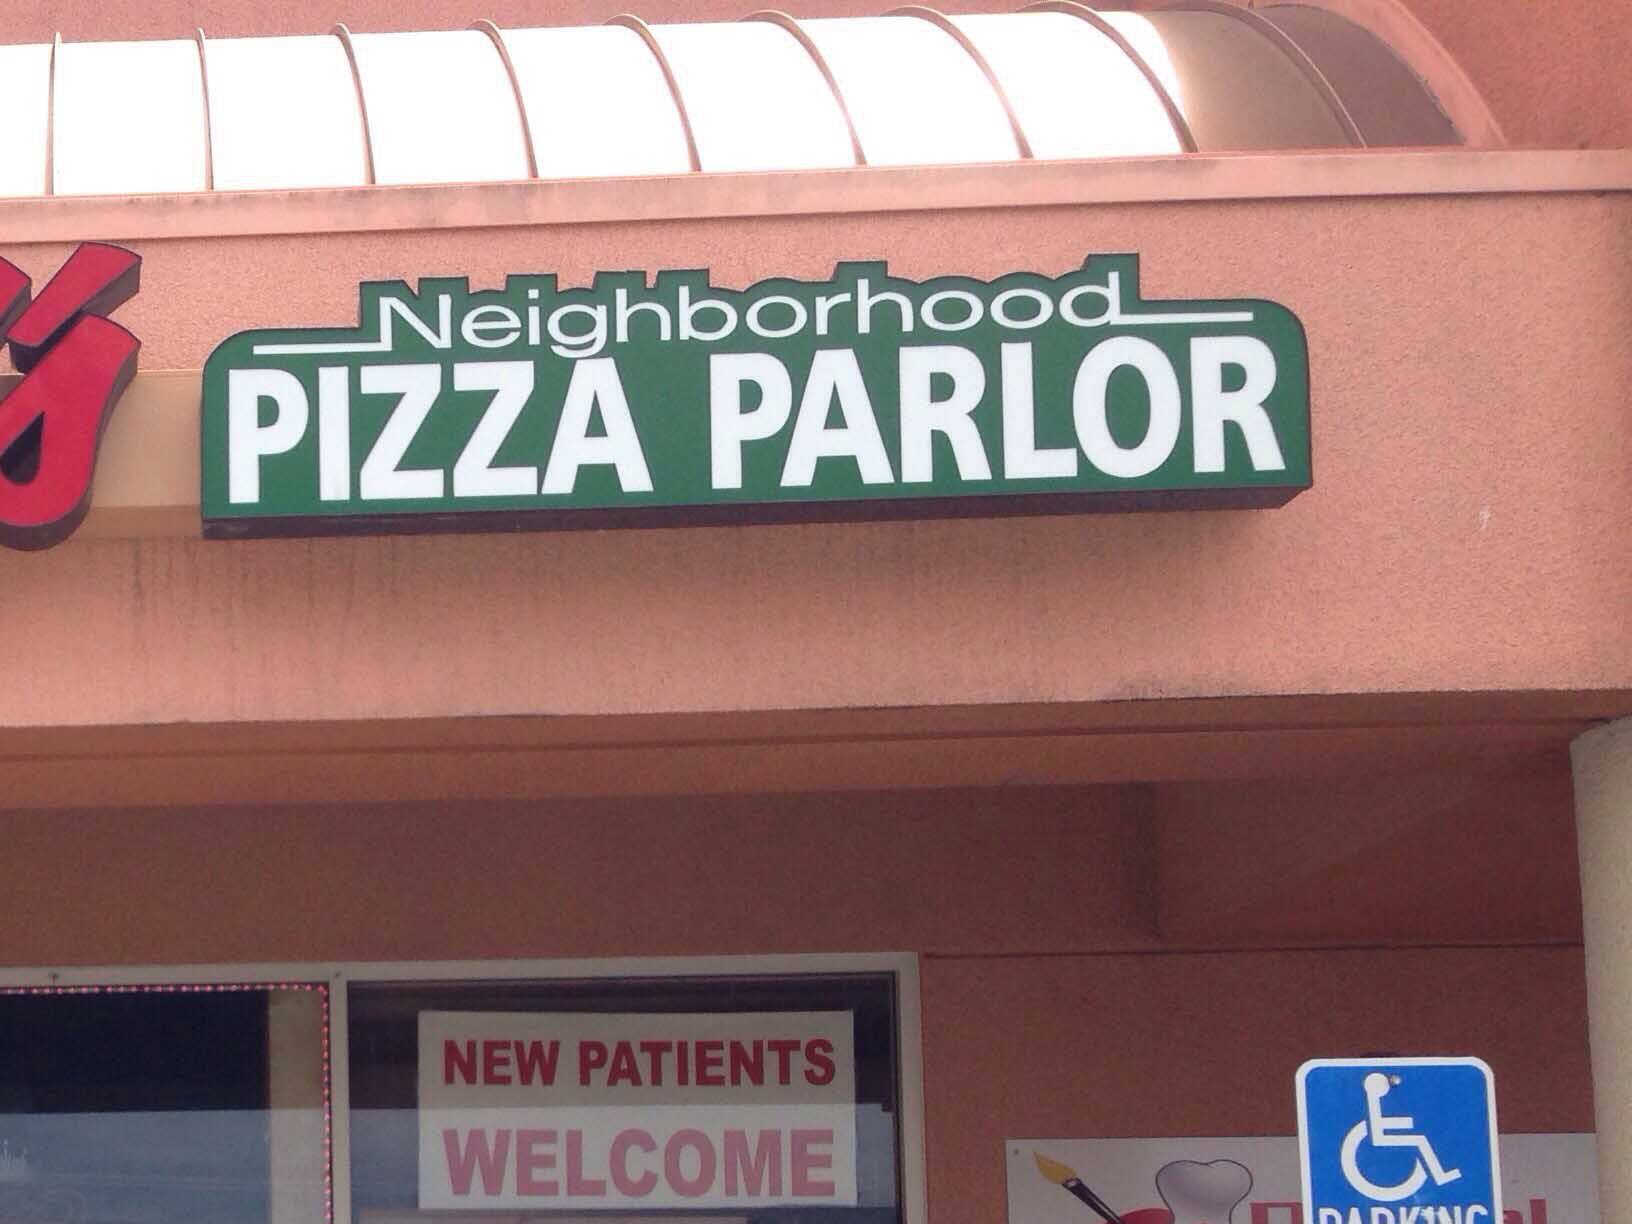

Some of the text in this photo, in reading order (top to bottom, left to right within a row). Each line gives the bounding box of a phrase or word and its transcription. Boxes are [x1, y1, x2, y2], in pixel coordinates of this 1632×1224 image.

[378, 271, 1120, 357] Neighborhood
[228, 336, 1285, 505] PIZZA PARLOR
[443, 1039, 836, 1087] NEW PATIENTS
[443, 1128, 836, 1198] WELCOME
